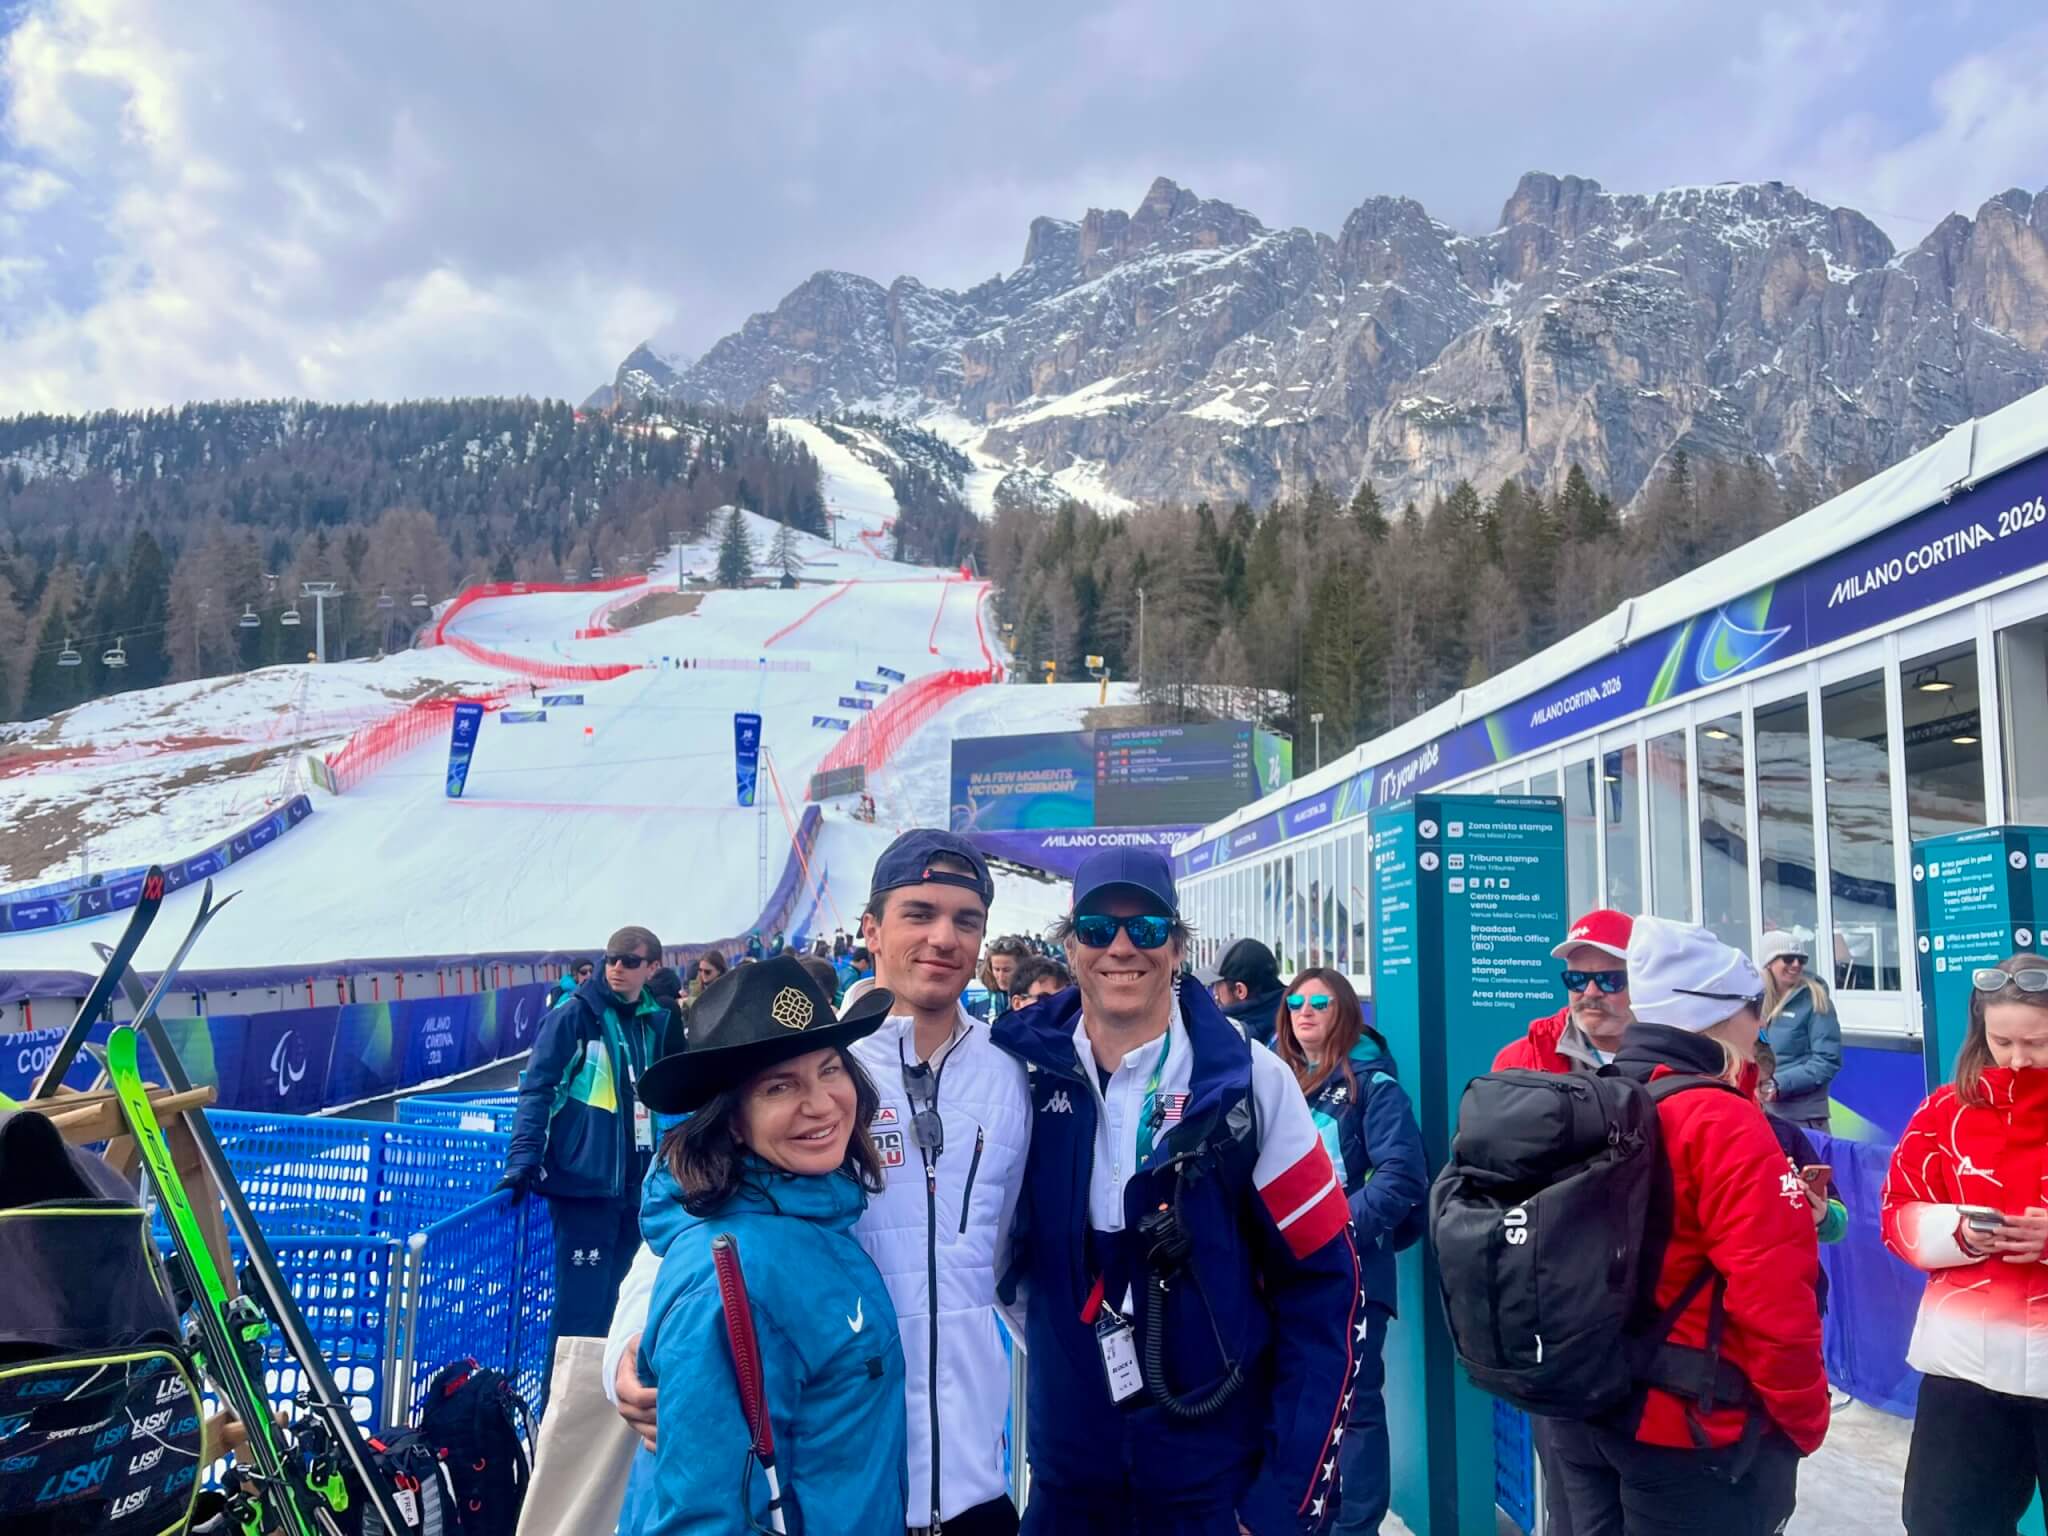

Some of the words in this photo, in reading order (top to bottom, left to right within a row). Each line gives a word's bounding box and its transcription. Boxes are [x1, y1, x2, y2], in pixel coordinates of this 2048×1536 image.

[1828, 559, 1902, 608] MILANO
[1905, 523, 1995, 575] CORTINA
[1998, 496, 2046, 537] 2026
[1530, 701, 1563, 728] MILANO
[1564, 686, 1601, 713] CORTINA
[1601, 675, 1622, 698] 2026
[1016, 768, 1072, 782] MOMENTS
[967, 783, 1014, 797] VICTORY
[1015, 780, 1078, 793] CEREMONY
[1468, 822, 1491, 830] Zona
[1492, 822, 1517, 831] mista
[1519, 823, 1553, 833] stampa
[1041, 833, 1096, 847] MILANO
[1098, 833, 1157, 846] CORTINA
[1469, 854, 1502, 862] Tribuna
[1504, 855, 1540, 864] stampa
[1470, 892, 1500, 901] Centro
[1502, 893, 1530, 901] media
[1470, 902, 1498, 910] venue
[1471, 925, 1516, 933] Broadcast
[1471, 934, 1523, 943] Information
[1524, 935, 1550, 943] Office
[1472, 942, 1494, 952] (BIO)
[1472, 957, 1491, 966] Sala
[1493, 958, 1542, 967] conferenza
[1472, 967, 1507, 976] stampa
[1472, 990, 1494, 998] Area
[1495, 989, 1524, 999] ristoro
[1525, 990, 1554, 999] media
[1503, 1200, 1528, 1245] SU
[155, 1375, 188, 1400] LIS
[46, 1427, 78, 1440] SPORT
[129, 1446, 164, 1470] LISKI
[35, 1455, 113, 1502] LISKI
[111, 1486, 151, 1515] LISKI
